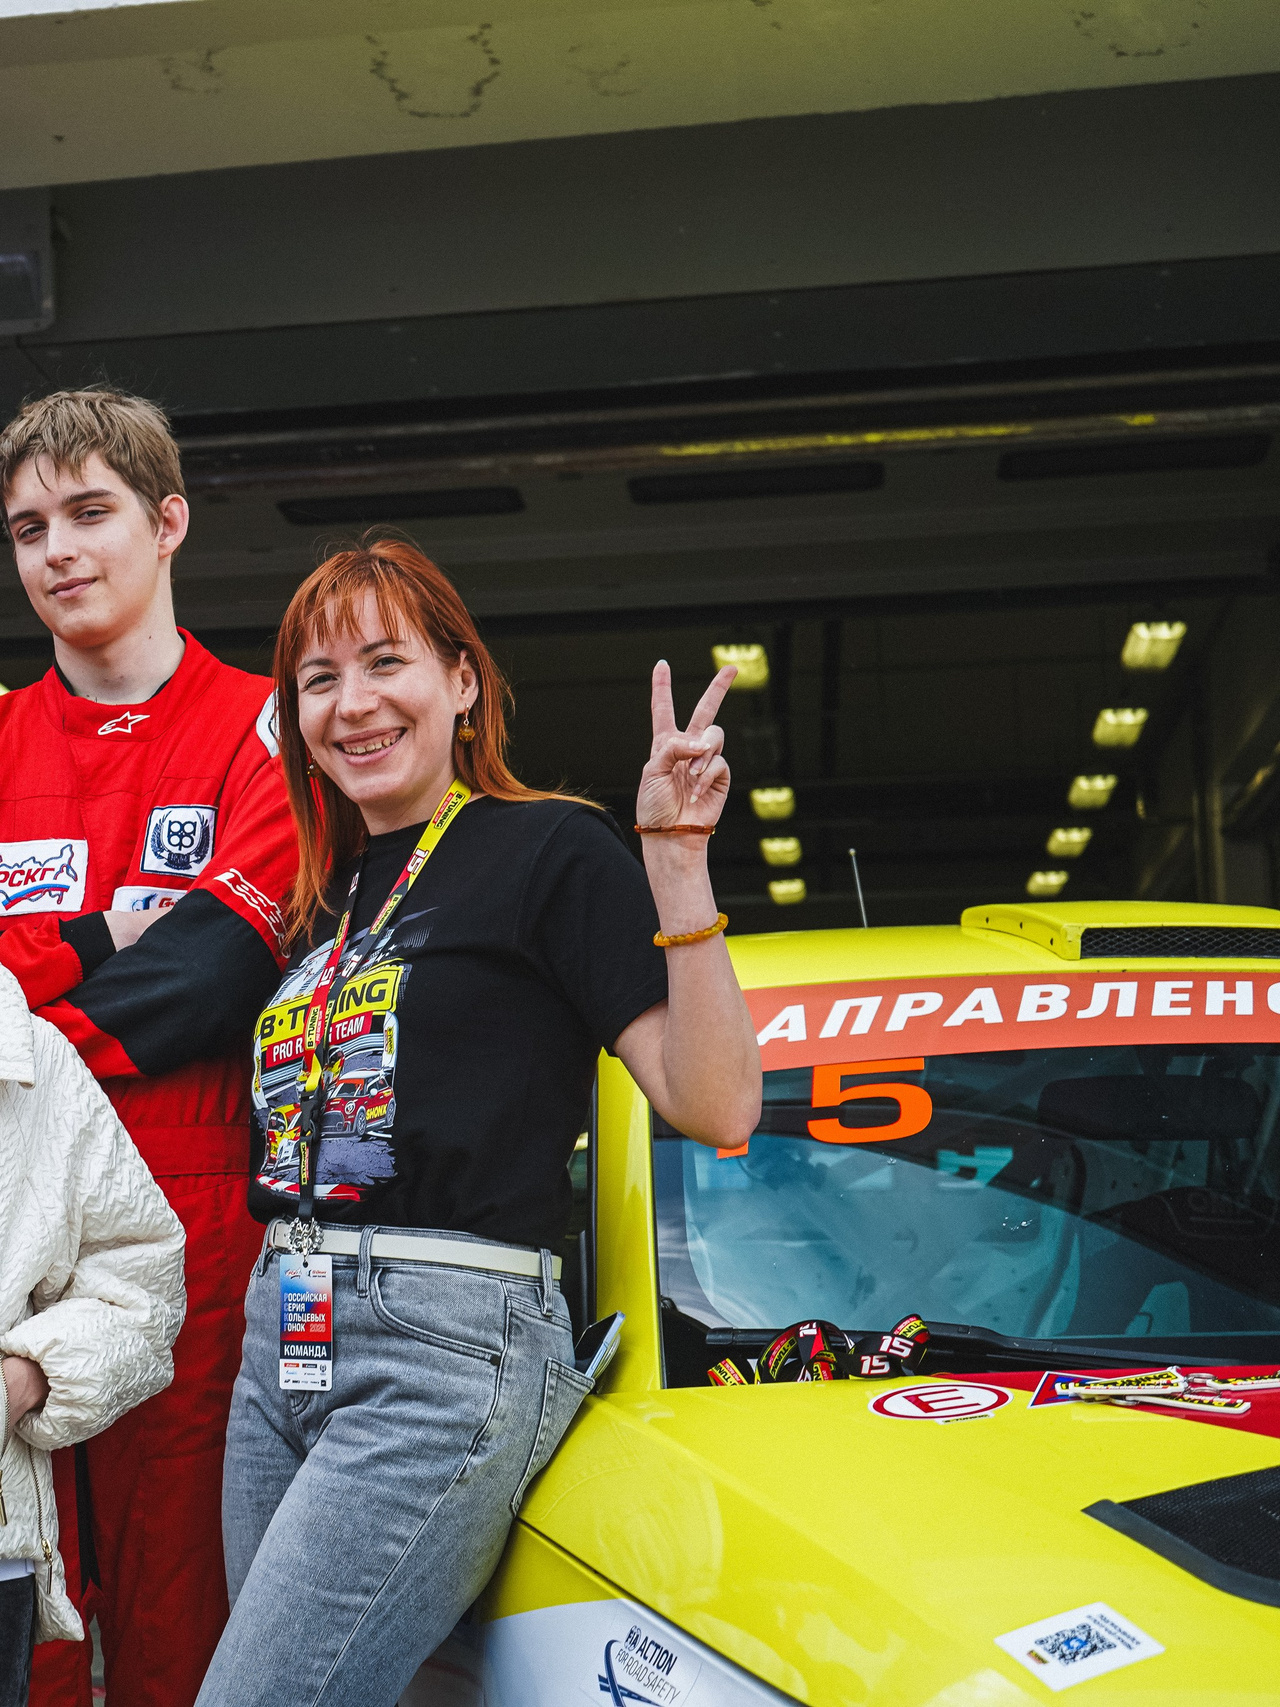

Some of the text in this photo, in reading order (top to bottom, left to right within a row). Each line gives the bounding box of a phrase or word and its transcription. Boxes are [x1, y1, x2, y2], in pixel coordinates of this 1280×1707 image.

[407, 848, 429, 875] 15
[318, 965, 335, 988] 15
[342, 954, 363, 978] 15
[758, 980, 1280, 1046] АПРАВЛЕН
[273, 1039, 294, 1062] PRO
[336, 1016, 365, 1040] TEAM
[283, 1292, 327, 1302] РОССИЙСКАЯ
[283, 1303, 305, 1312] СЕРИЯ
[283, 1313, 326, 1323] КОЛЬЦЕВЫХ
[283, 1323, 306, 1332] ГОНОК
[284, 1345, 327, 1357] КОМАНДА
[879, 1335, 914, 1358] 15
[861, 1355, 890, 1375] 15
[636, 1636, 678, 1676] ACTION
[615, 1648, 681, 1704] FOR ROAD SAFETY
